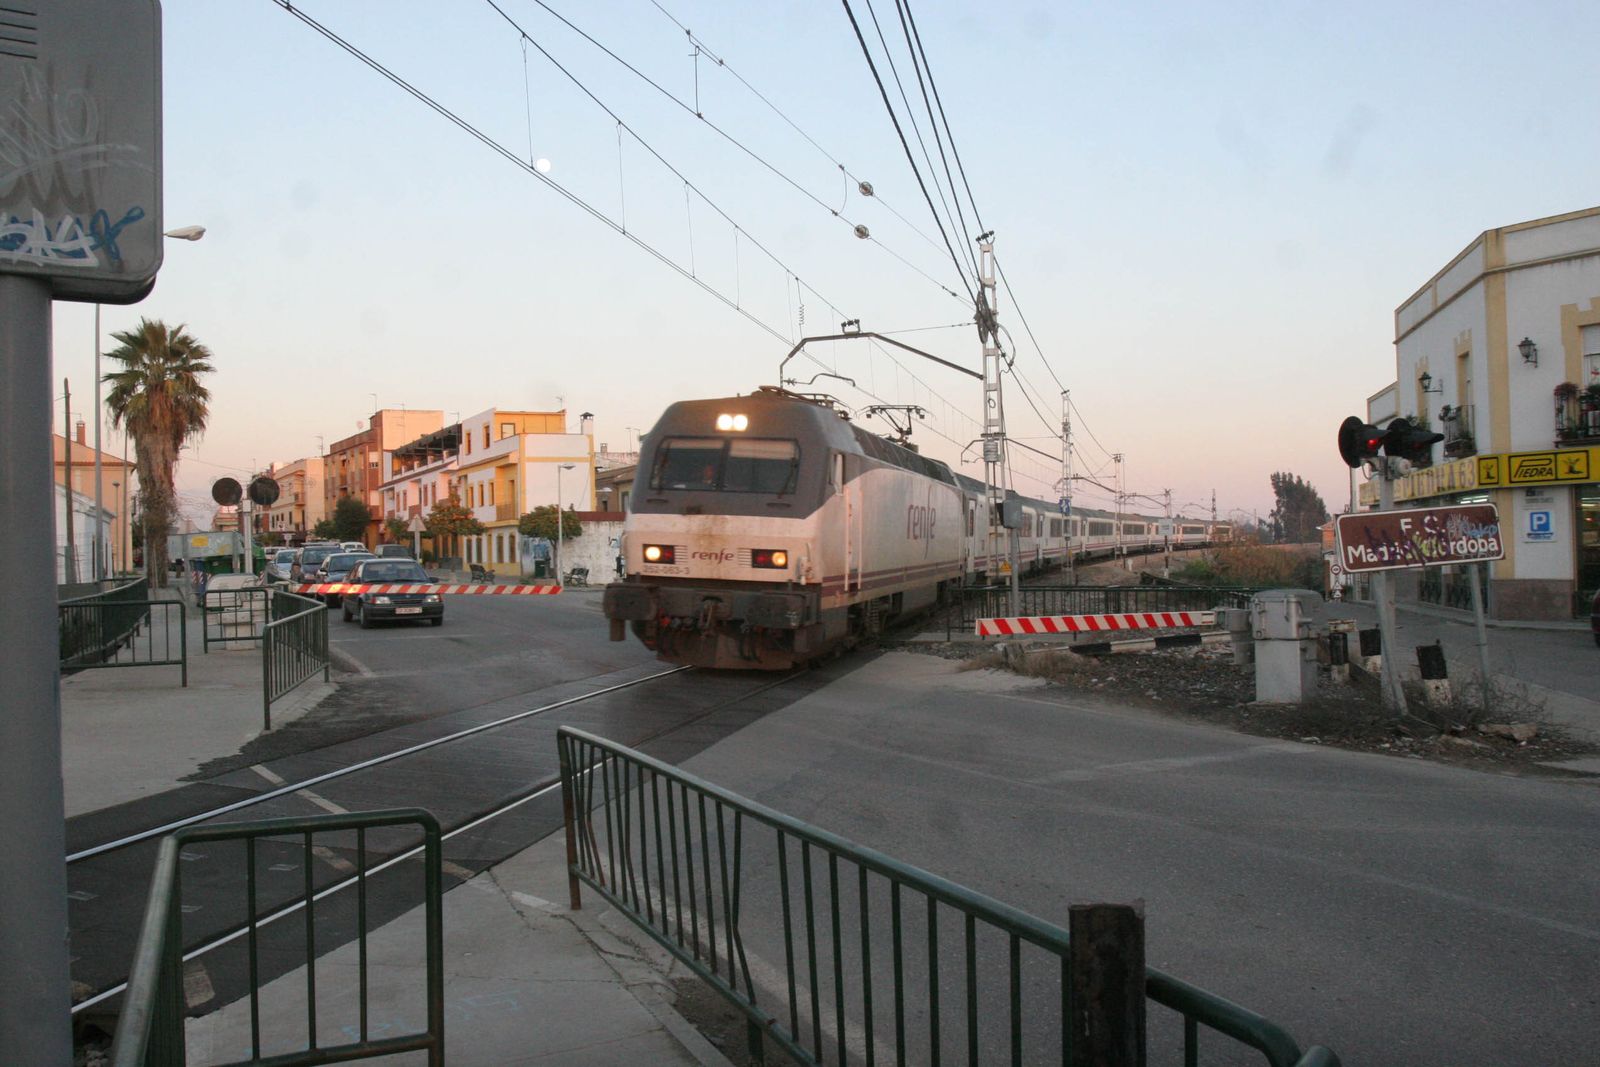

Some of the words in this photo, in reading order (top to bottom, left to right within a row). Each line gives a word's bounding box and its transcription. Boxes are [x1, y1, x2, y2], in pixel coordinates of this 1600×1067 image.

[1514, 458, 1553, 478] PIEDRA
[906, 484, 937, 560] renfe
[1532, 513, 1547, 531] P
[691, 547, 735, 565] renfe
